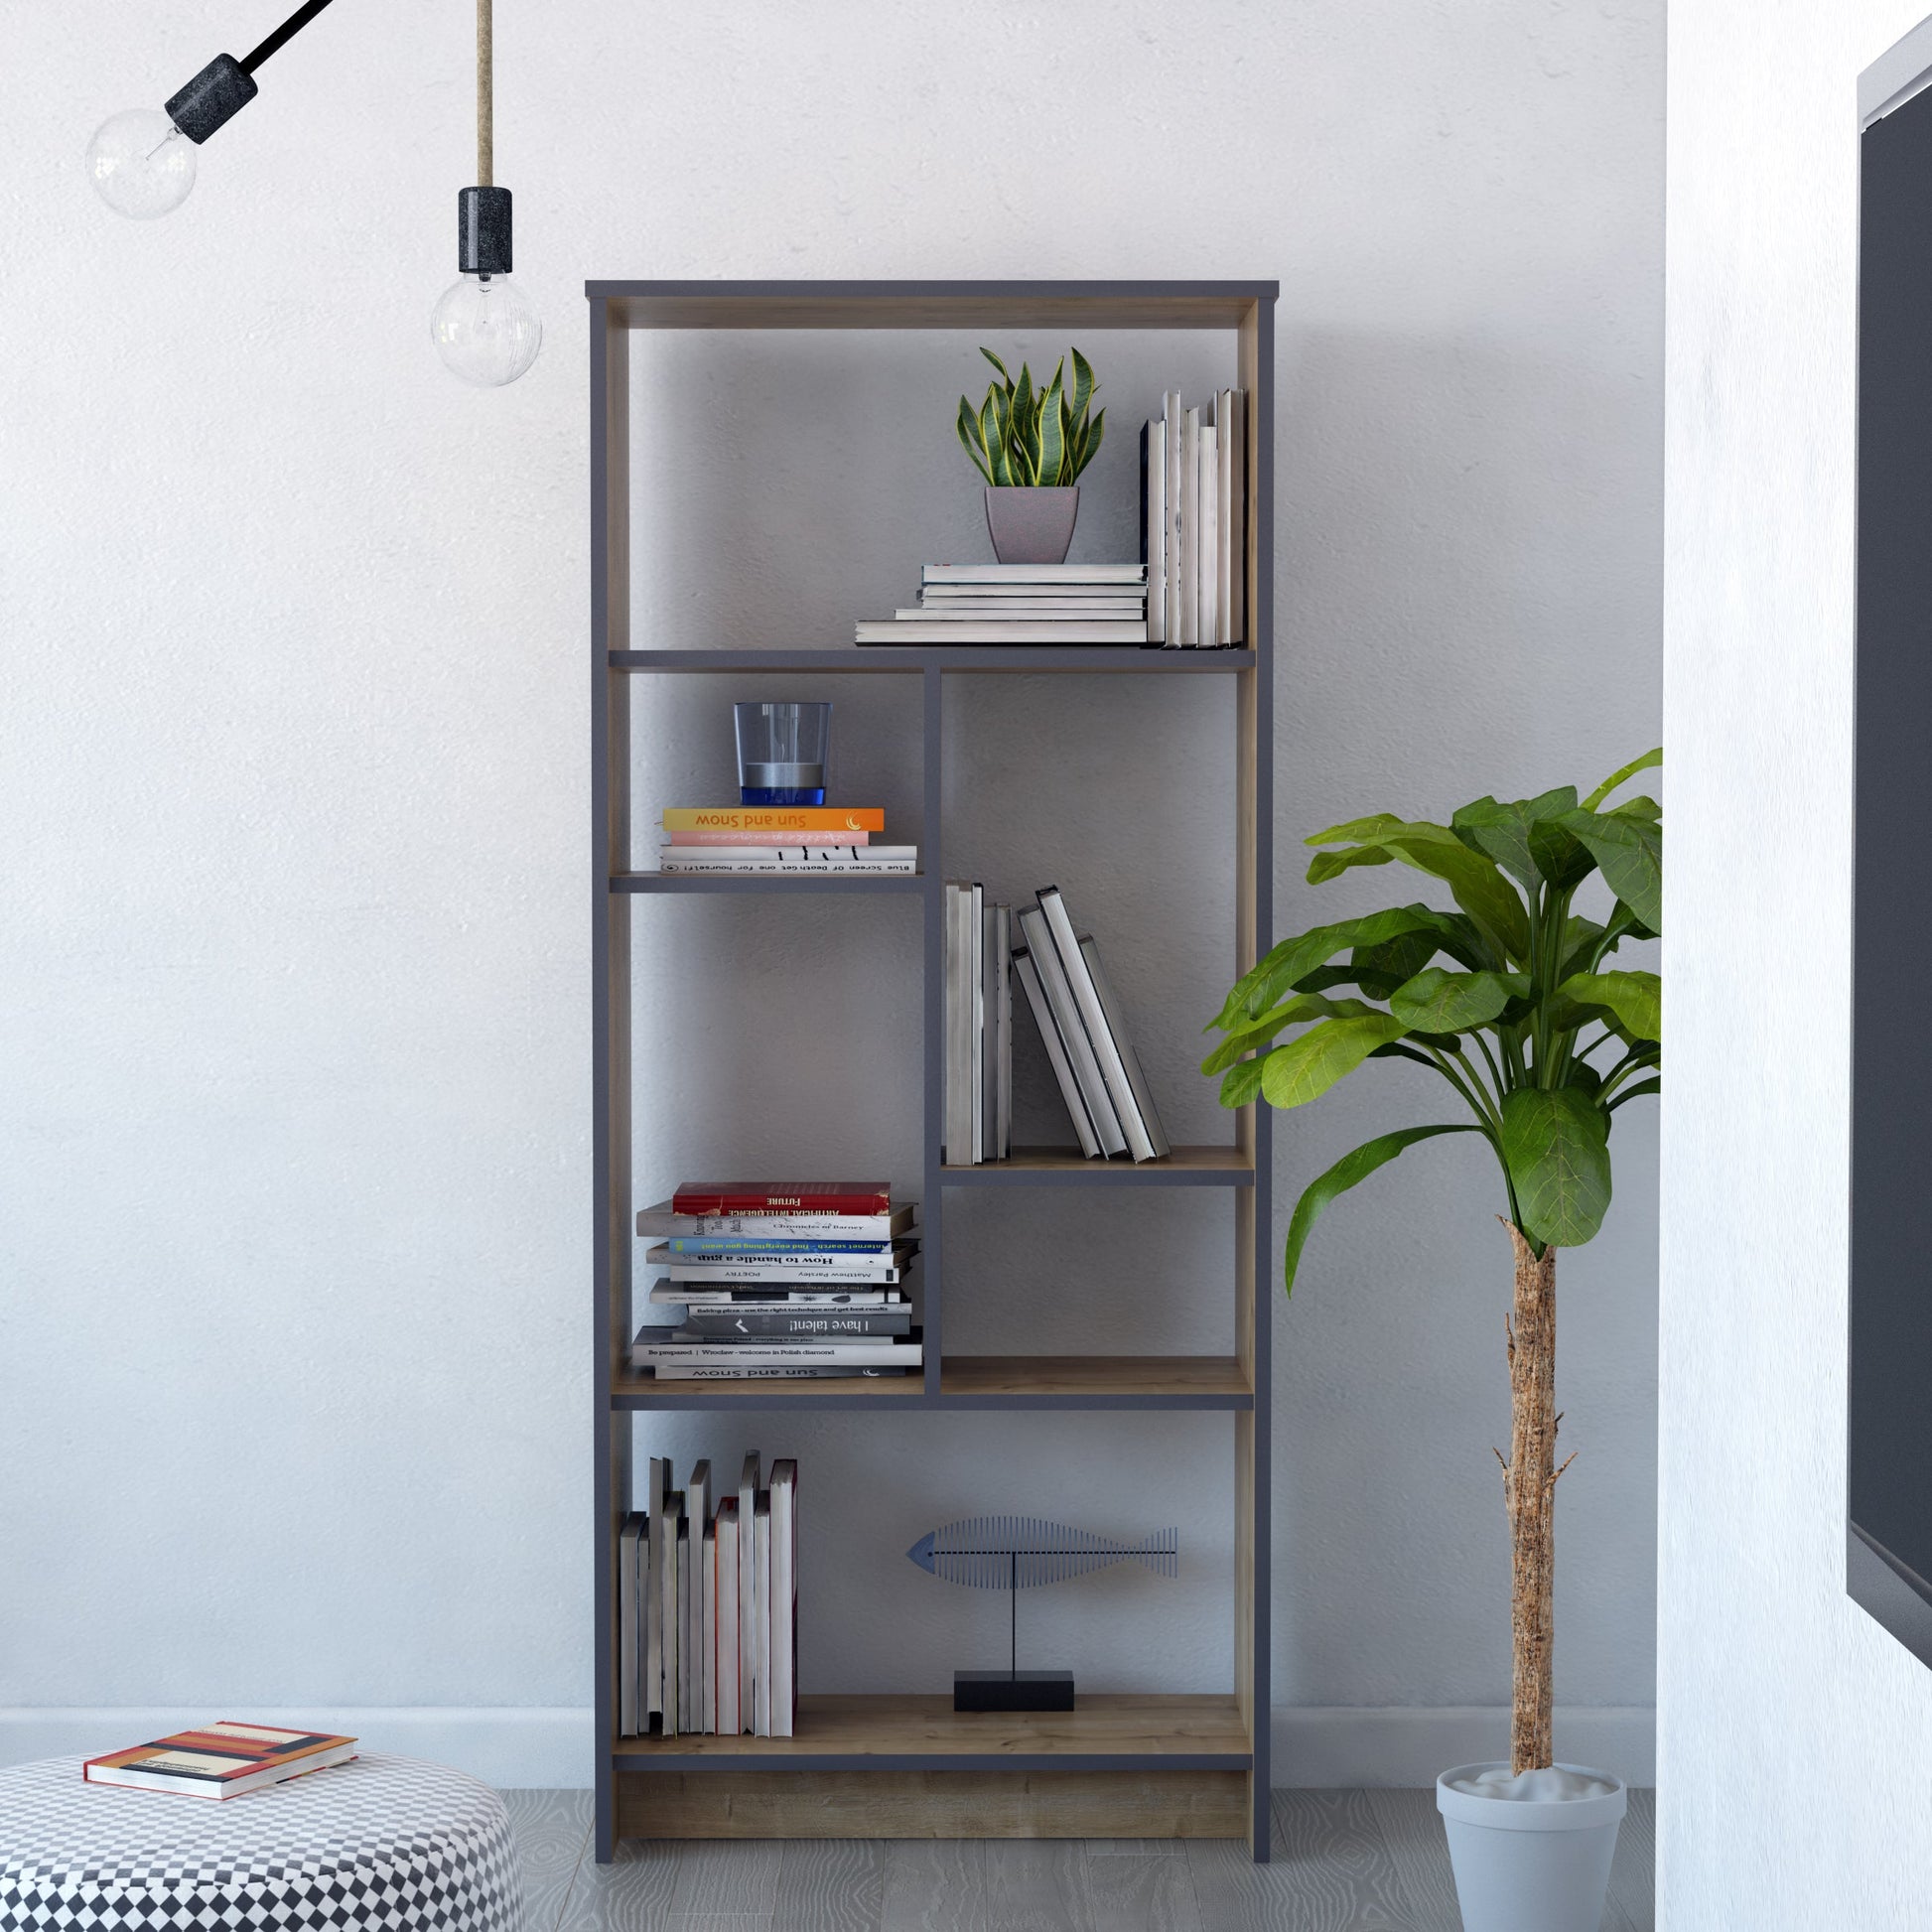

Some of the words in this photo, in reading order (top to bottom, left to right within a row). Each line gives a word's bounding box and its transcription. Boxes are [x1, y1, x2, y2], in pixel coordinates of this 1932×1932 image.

[695, 815, 739, 828] Snow
[744, 815, 772, 828] and
[778, 815, 806, 828] Sun
[766, 1197, 801, 1206] FUTURE
[790, 1321, 828, 1332] talent!
[832, 1321, 861, 1332] have
[865, 1321, 869, 1331] I
